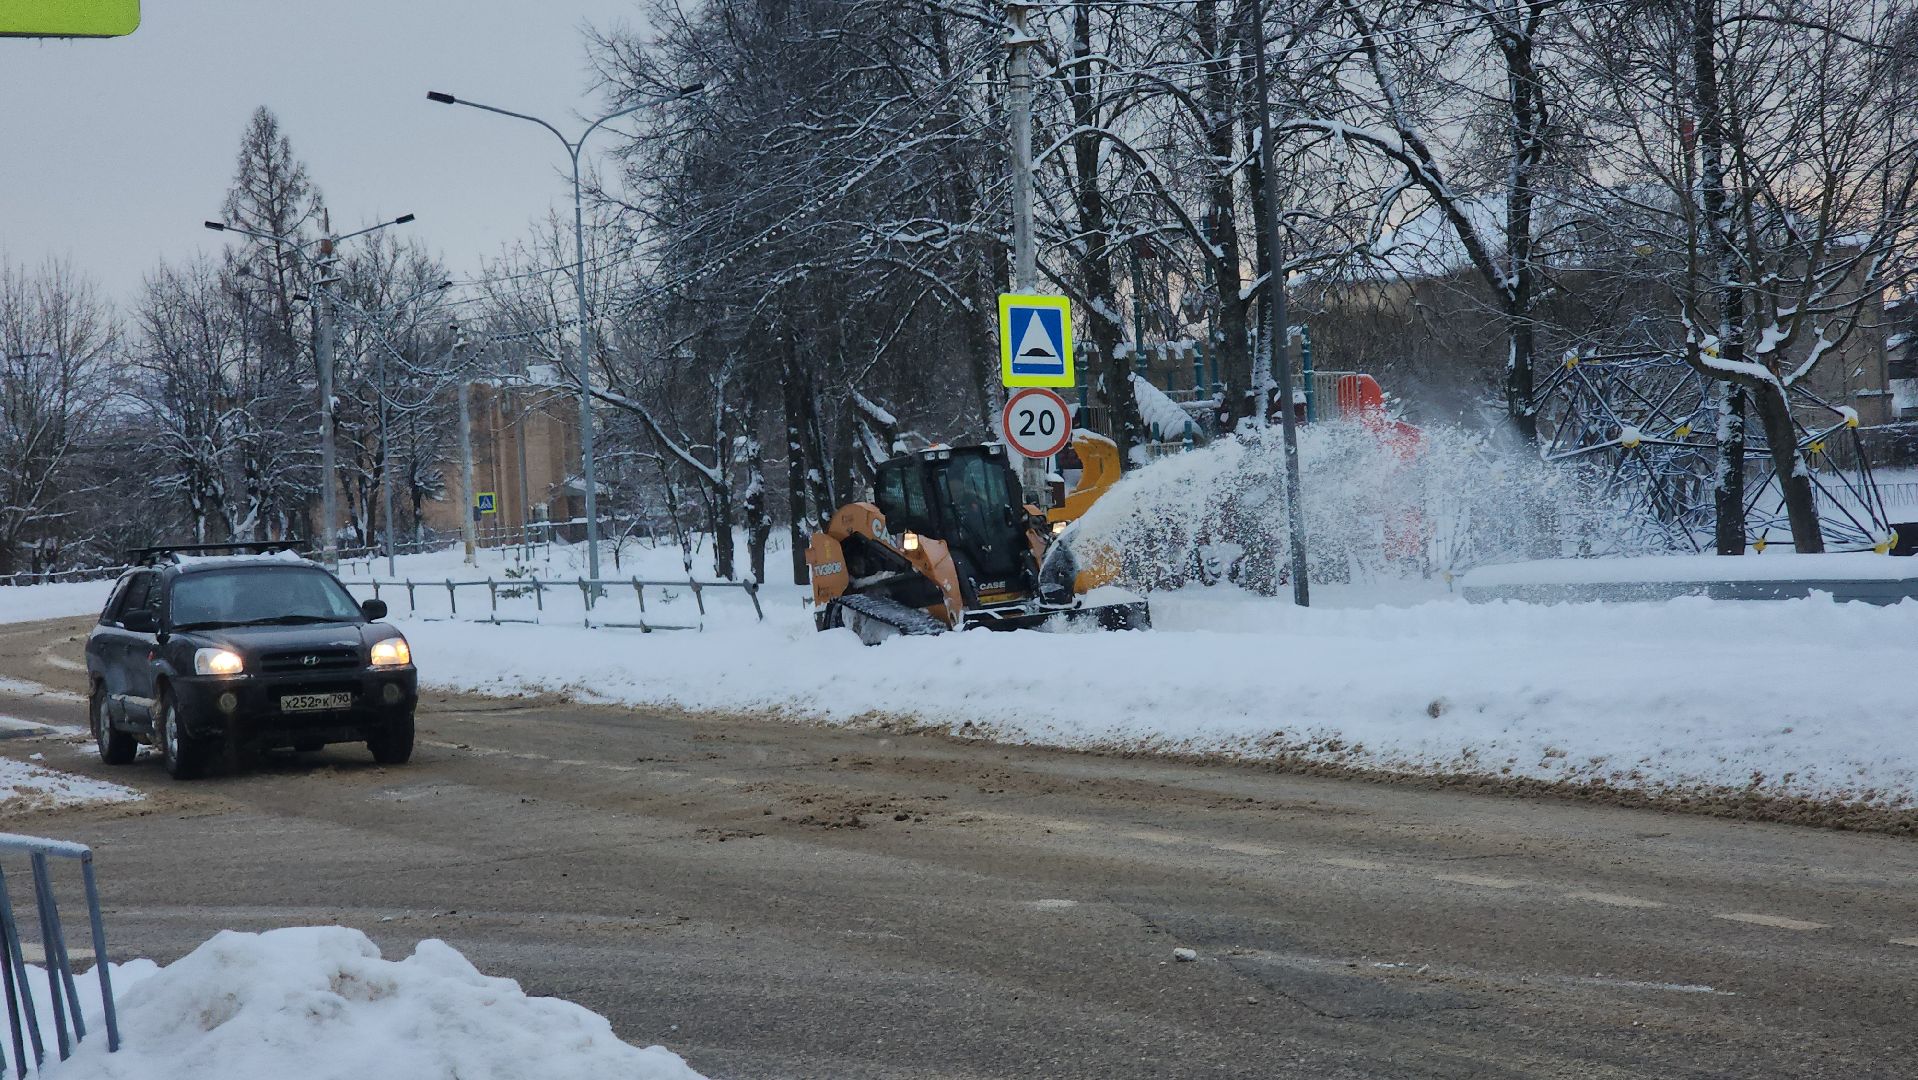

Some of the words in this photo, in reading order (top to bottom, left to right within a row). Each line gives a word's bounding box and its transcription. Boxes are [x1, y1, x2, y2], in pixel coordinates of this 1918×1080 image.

[1019, 409, 1055, 436] 20
[979, 580, 1006, 590] CASE
[331, 694, 349, 704] 790
